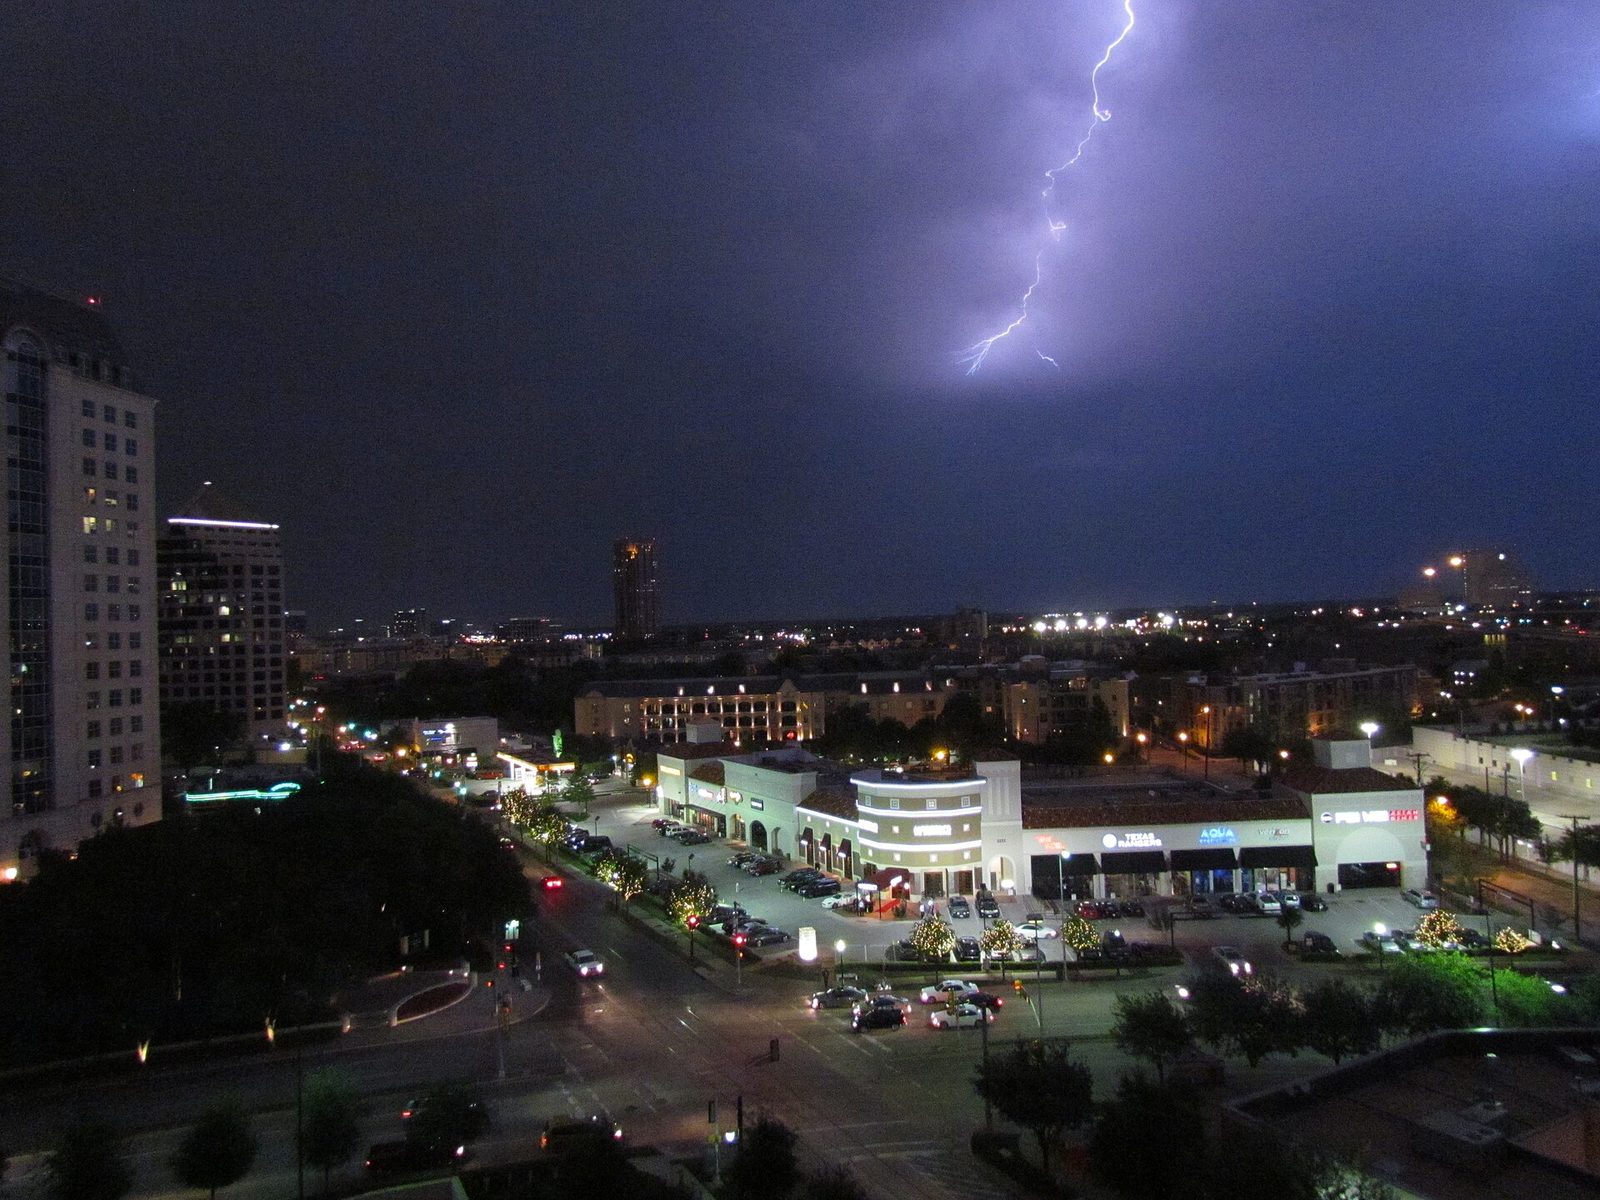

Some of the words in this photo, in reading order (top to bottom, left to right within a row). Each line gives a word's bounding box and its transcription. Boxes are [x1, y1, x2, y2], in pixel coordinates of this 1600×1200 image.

[1125, 832, 1155, 841] TEXAS
[1201, 827, 1234, 838] AQUA
[1117, 839, 1162, 848] RANGERS
